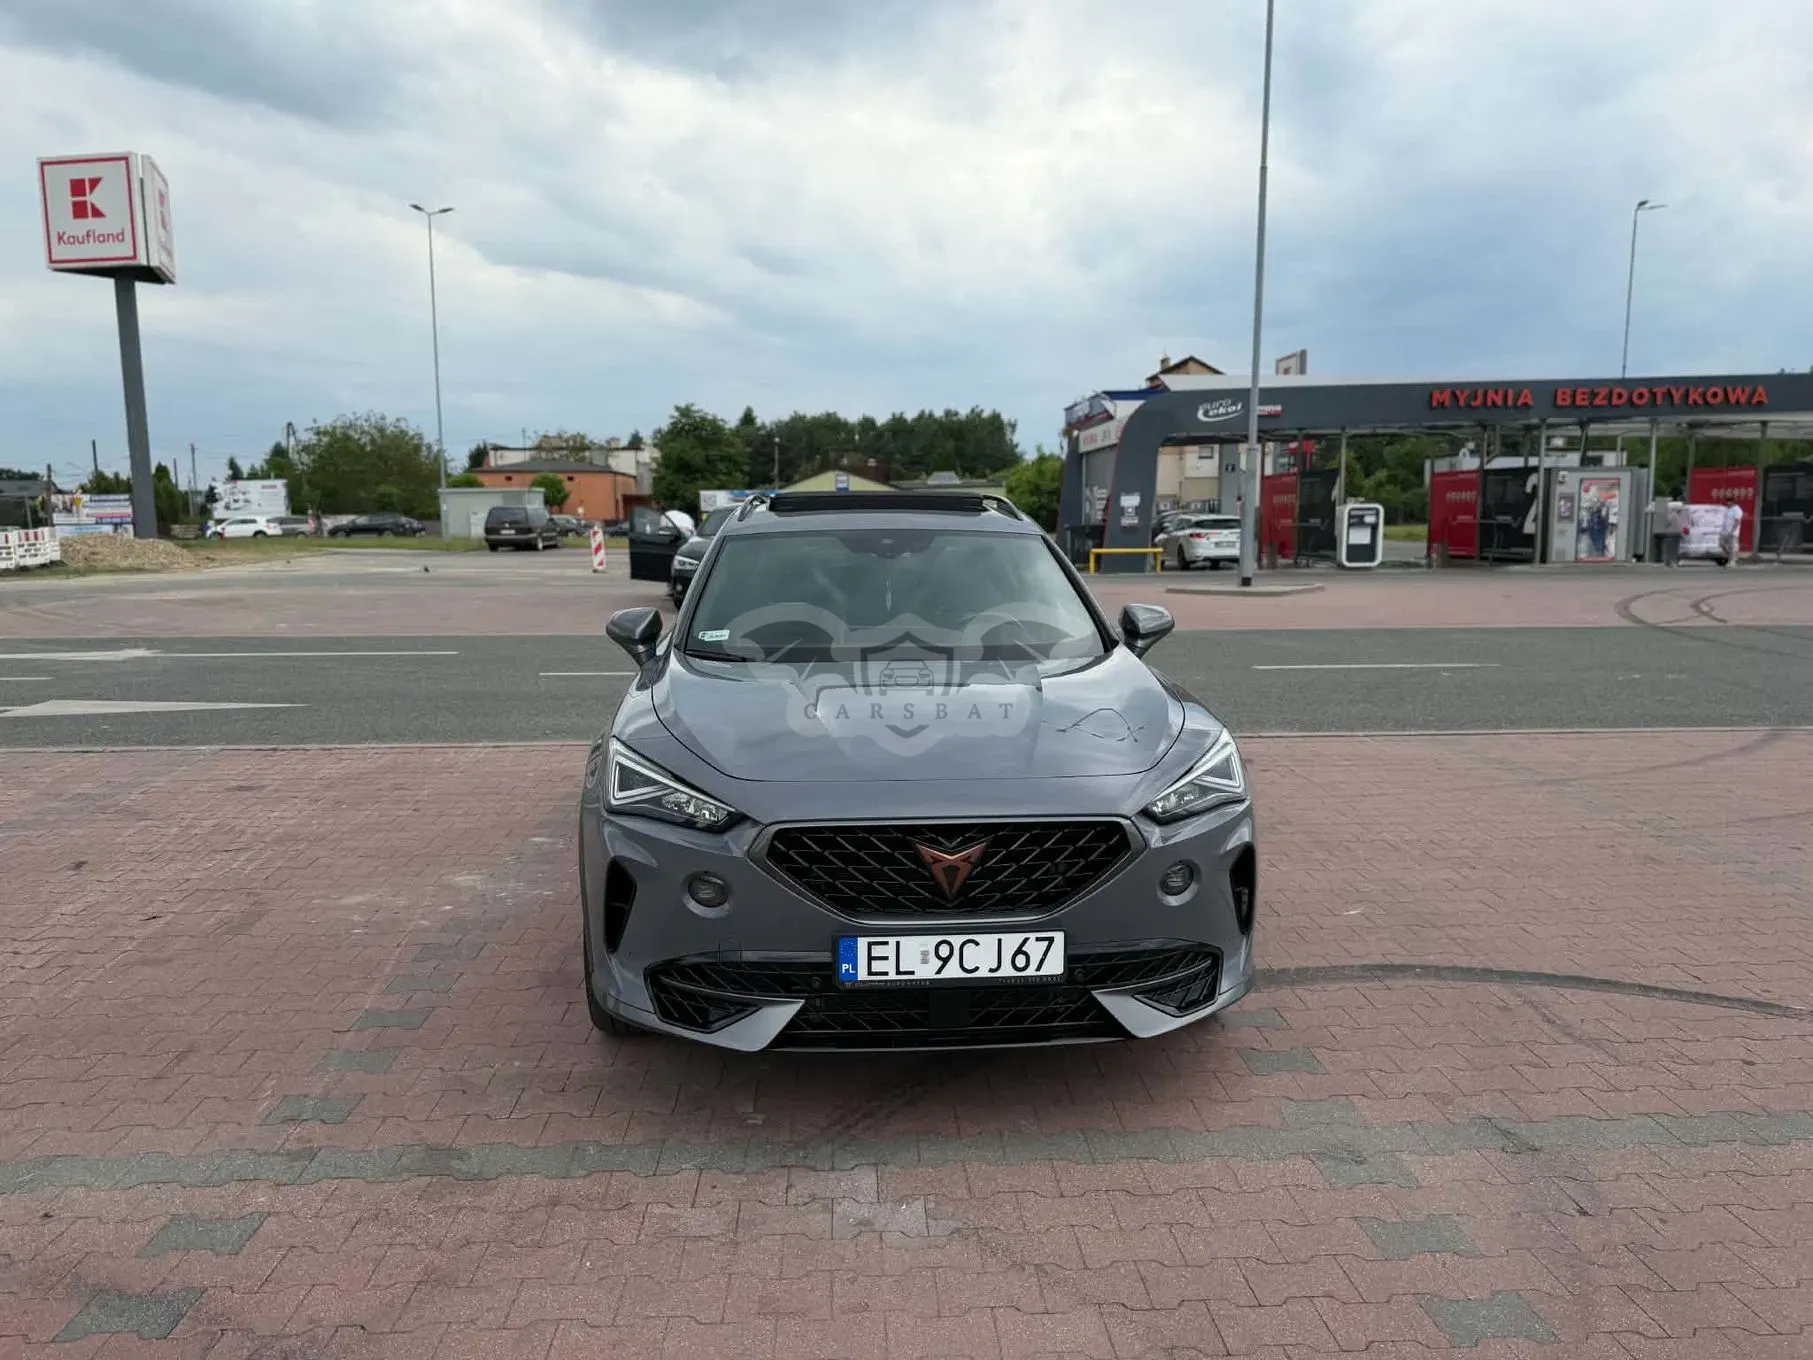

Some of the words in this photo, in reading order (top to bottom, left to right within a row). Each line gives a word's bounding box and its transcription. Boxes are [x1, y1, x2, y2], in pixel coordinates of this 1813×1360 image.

[70, 176, 107, 219] K
[56, 229, 125, 245] Kaufland
[1431, 387, 1534, 408] MYJNIA
[1555, 385, 1768, 406] BEZDOTYKOWA
[867, 940, 915, 976] EL
[934, 936, 1055, 975] 9CJ67
[842, 963, 856, 974] PL
